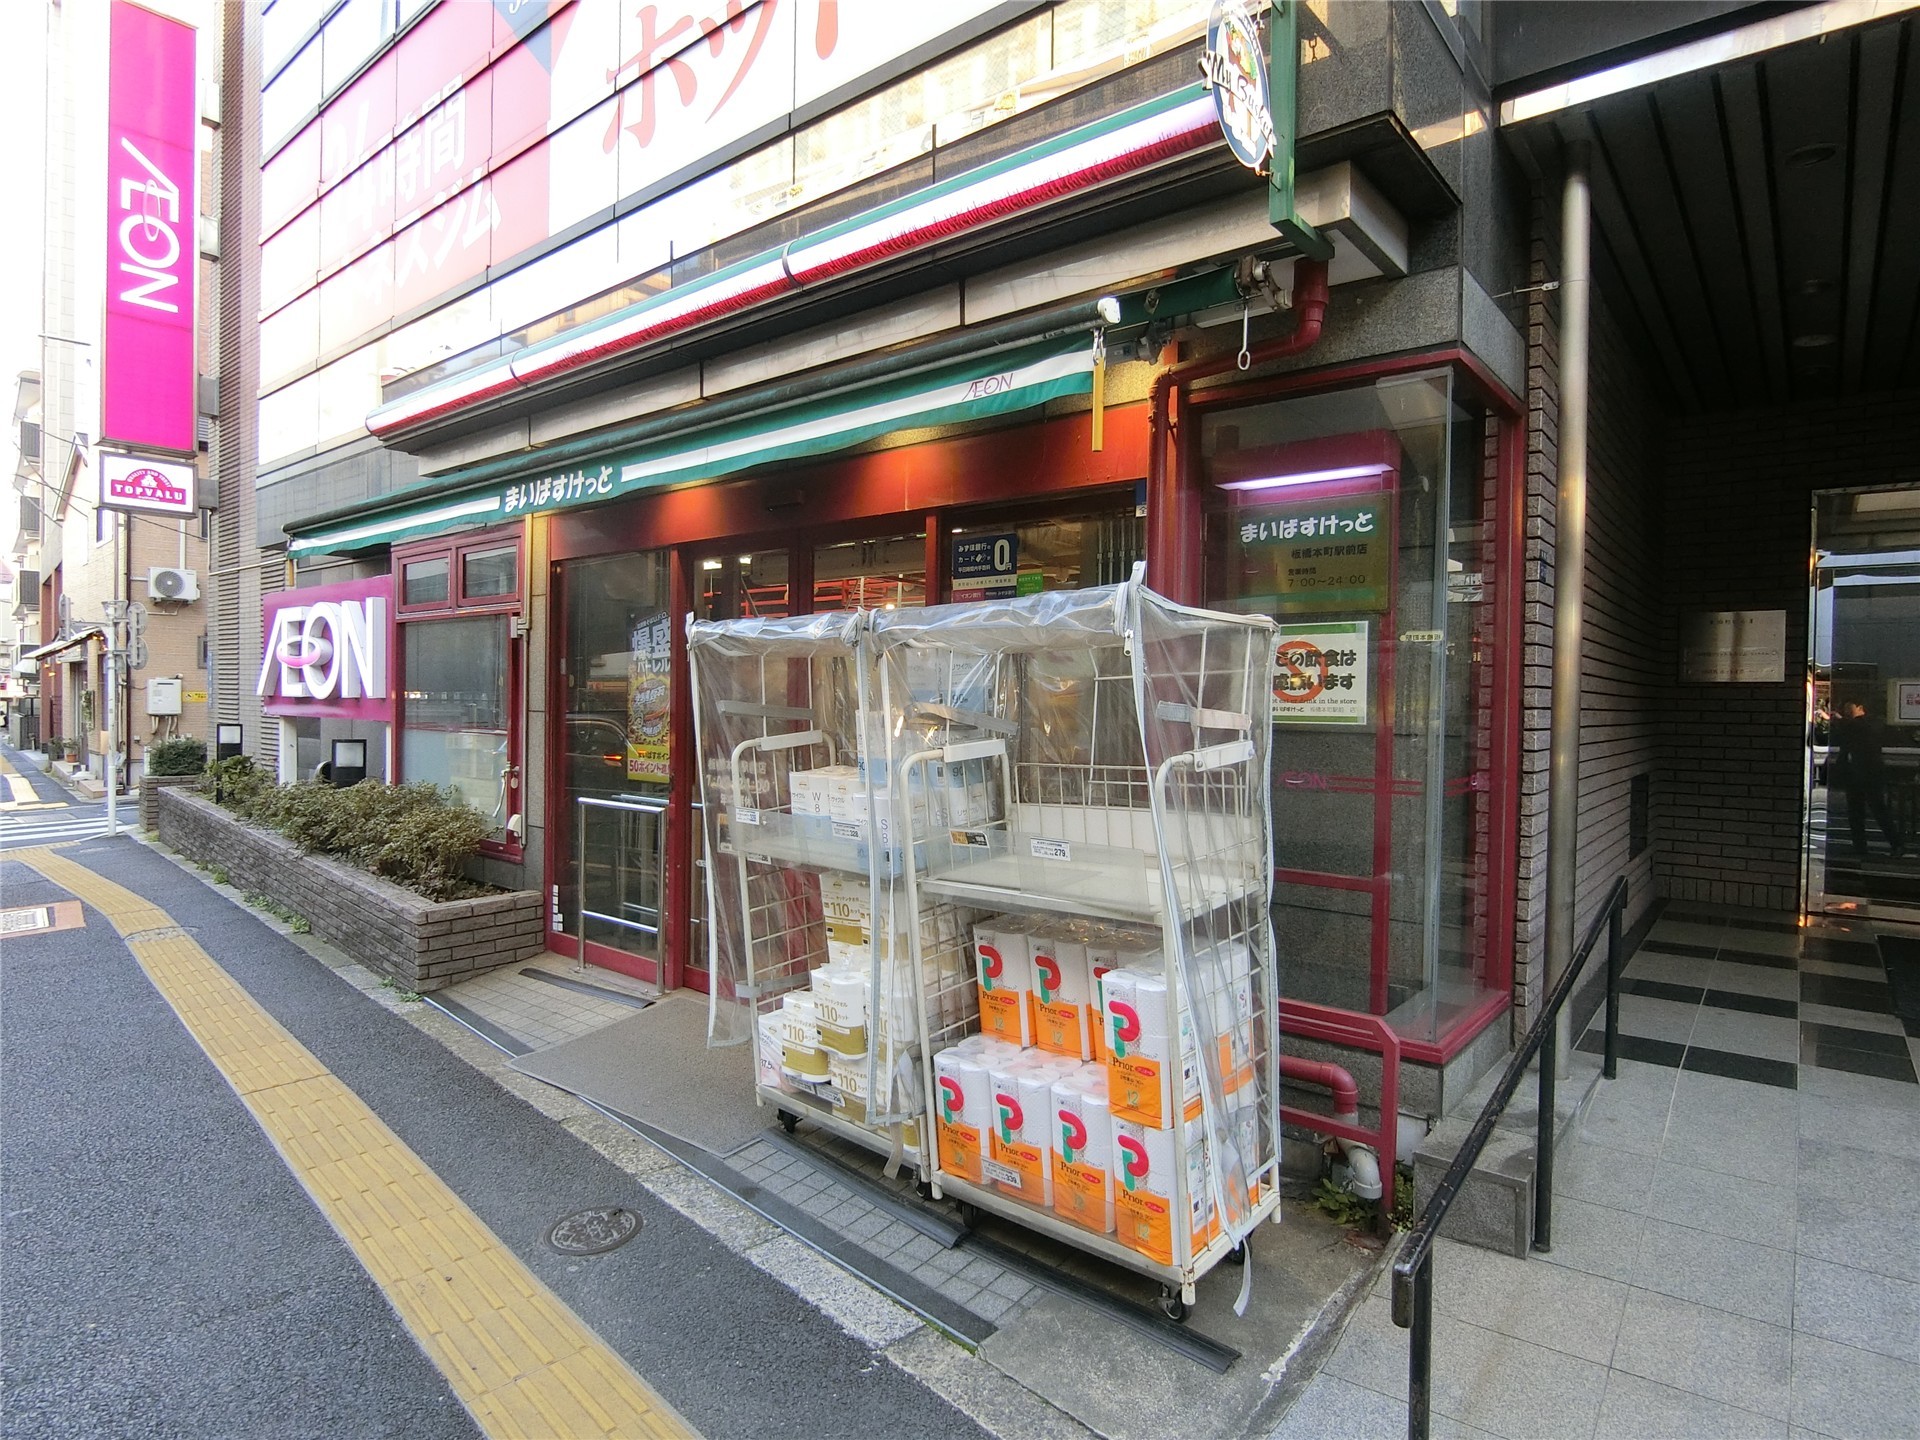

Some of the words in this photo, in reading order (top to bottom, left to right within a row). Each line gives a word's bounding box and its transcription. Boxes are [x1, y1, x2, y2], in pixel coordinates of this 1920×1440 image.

[114, 483, 183, 500] TOPVALU
[505, 465, 613, 512] まいばすけっと
[1240, 512, 1374, 543] まいばすけっと
[1291, 544, 1368, 559] 板橋本町駅前店
[830, 902, 850, 917] 110
[982, 991, 1000, 1002] Prior
[820, 1003, 838, 1022] 110
[1040, 1003, 1058, 1015] Prior
[787, 1024, 805, 1042] 110
[1112, 1057, 1134, 1072] Prior
[838, 1072, 857, 1092] 110
[1127, 1089, 1138, 1105] 12
[942, 1122, 960, 1136] Prior
[1000, 1142, 1019, 1156] Prior
[1060, 1161, 1081, 1177] Prior
[1122, 1189, 1144, 1206] Prior
